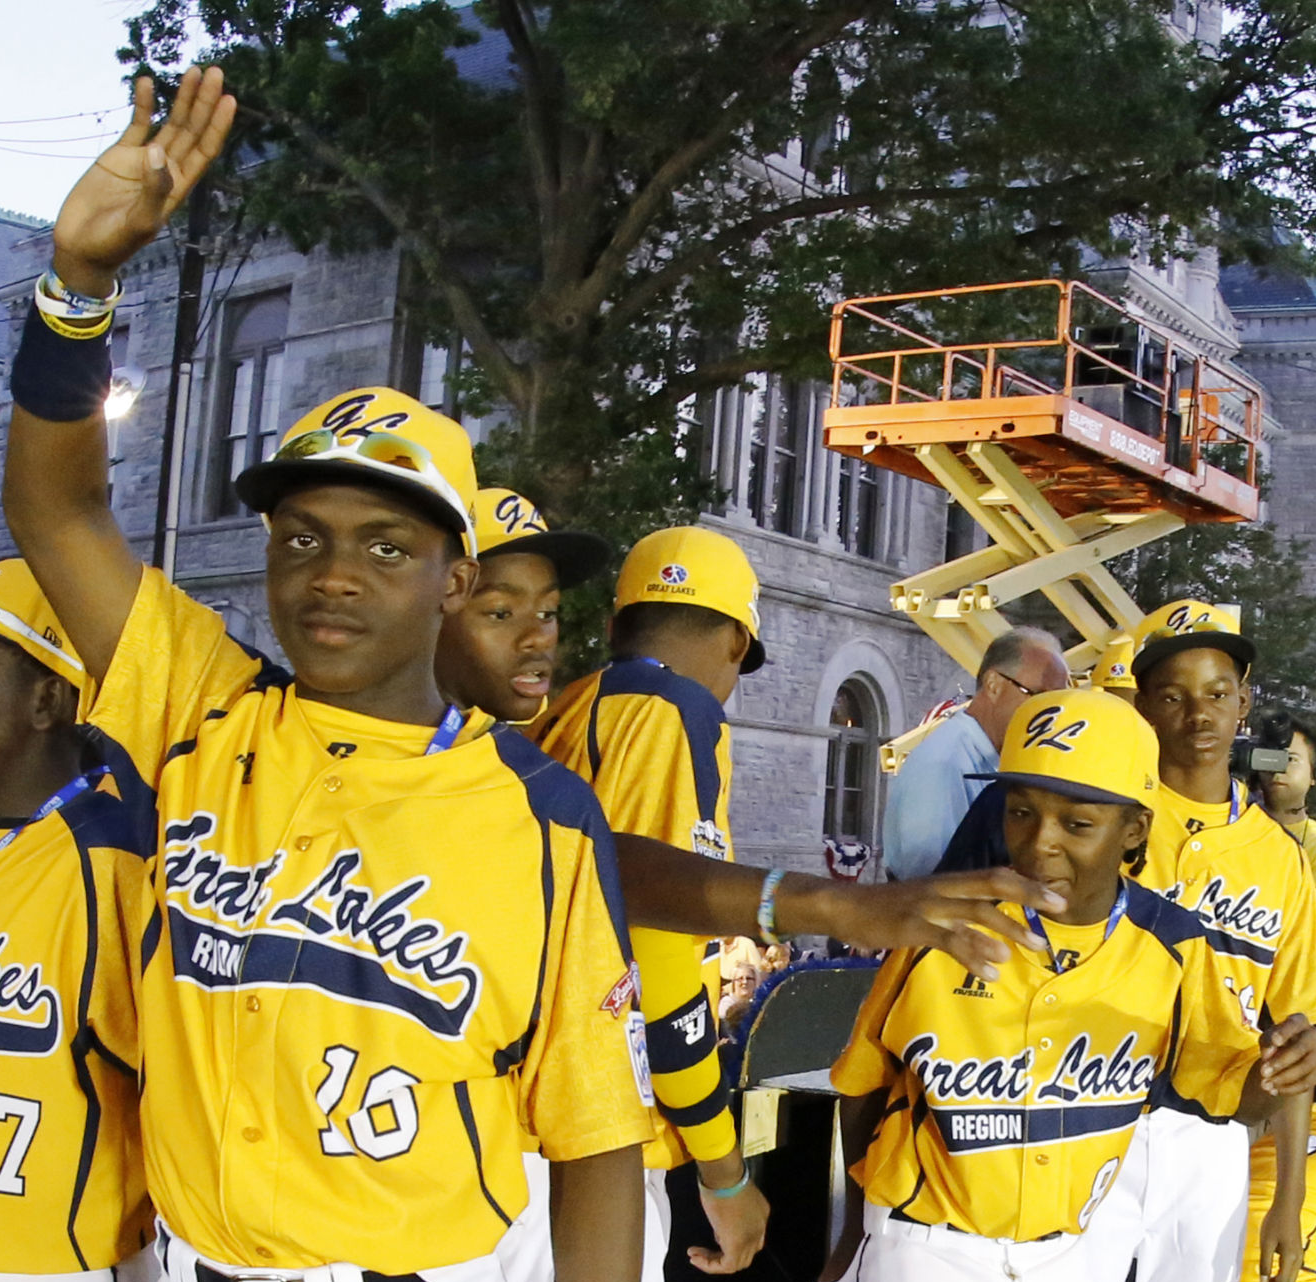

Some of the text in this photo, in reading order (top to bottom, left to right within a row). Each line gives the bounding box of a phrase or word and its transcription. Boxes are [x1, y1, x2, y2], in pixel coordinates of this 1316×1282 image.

[646, 583, 696, 596] GREAT LAKES
[1023, 705, 1088, 752] GL
[265, 848, 470, 985] Lakes
[1195, 875, 1282, 939] Lakes
[953, 988, 994, 999] RUSSELL
[901, 1032, 1035, 1101] Great
[316, 1044, 422, 1162] 10
[951, 1113, 1022, 1141] REGION
